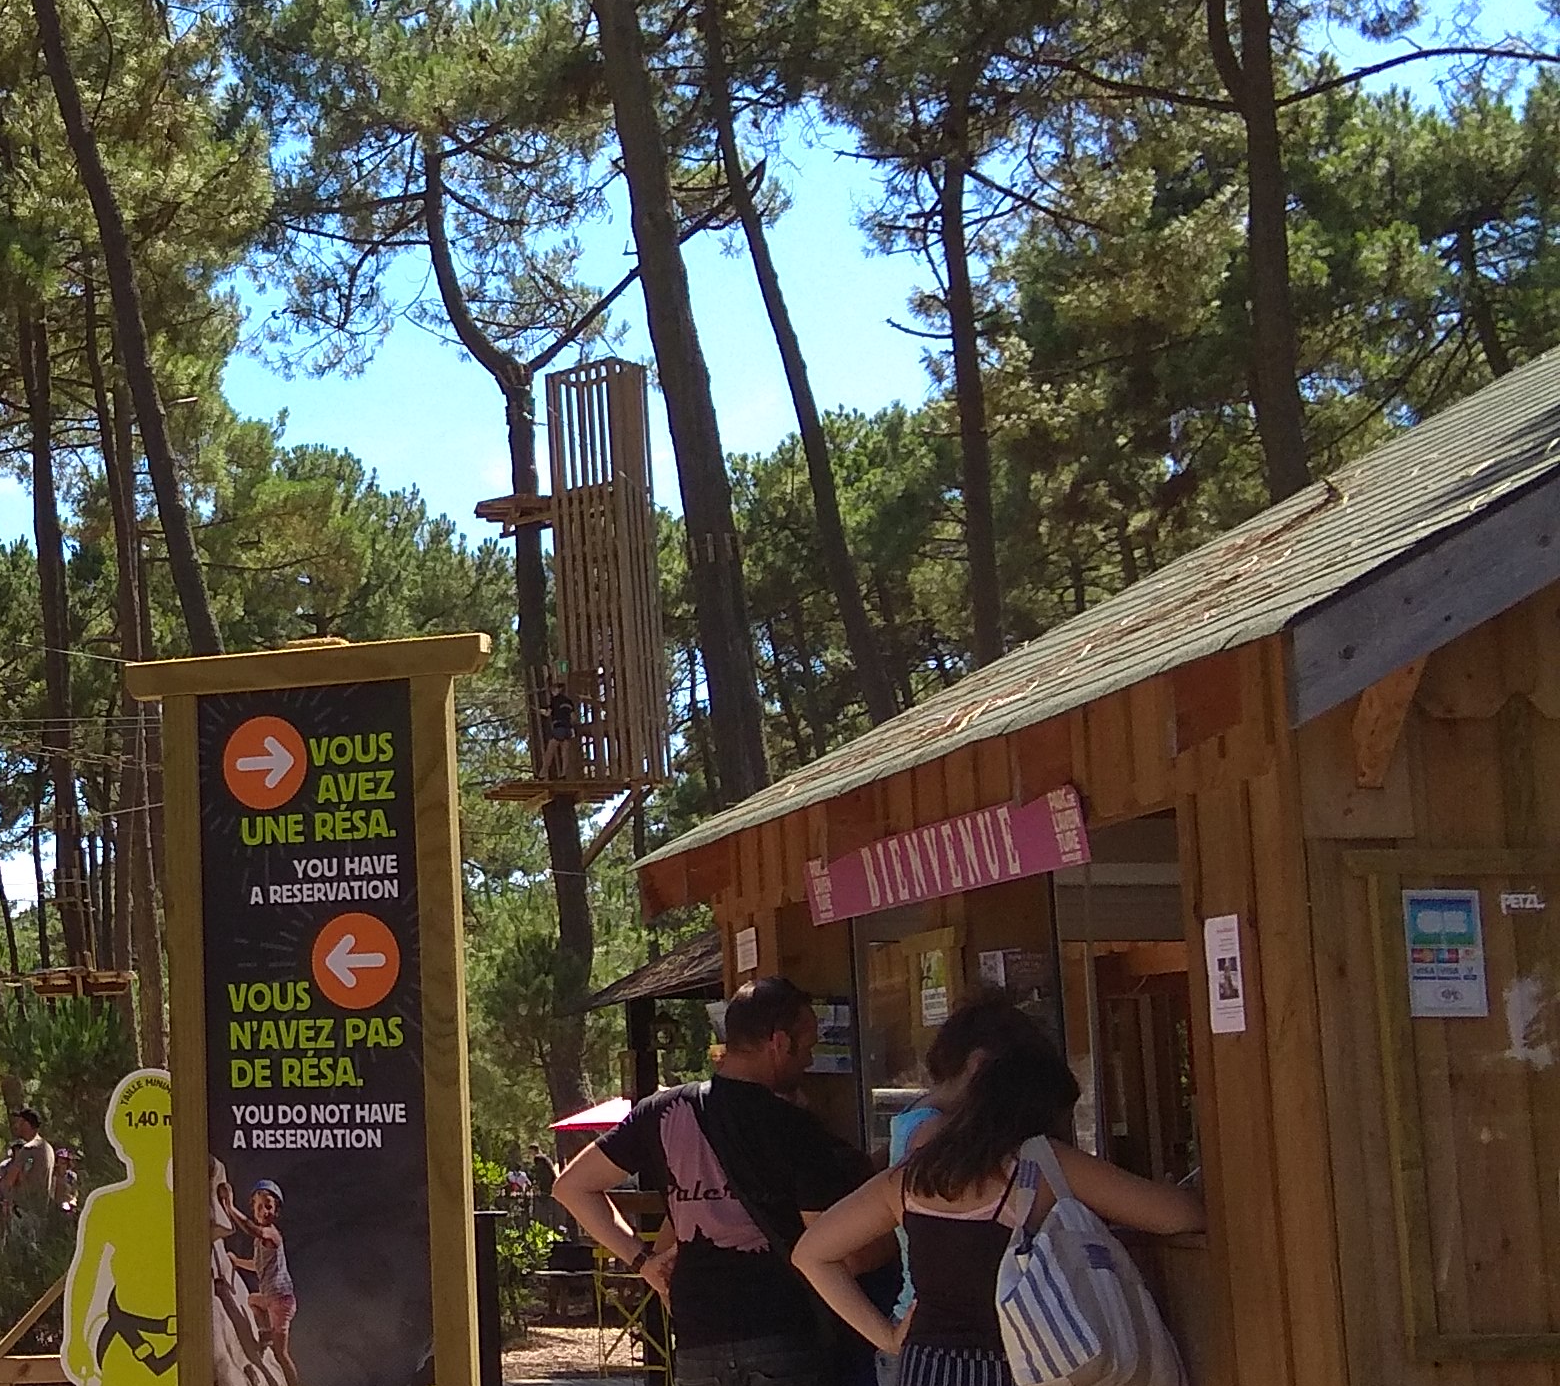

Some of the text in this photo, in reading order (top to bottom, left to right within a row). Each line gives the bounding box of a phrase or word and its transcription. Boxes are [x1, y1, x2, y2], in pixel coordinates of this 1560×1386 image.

[309, 732, 394, 766] VOUS
[317, 770, 396, 804] AVEZ
[241, 804, 397, 846] UNE RÉSA.
[293, 854, 399, 879] YOU HAVE
[861, 806, 1021, 907] BIENVENUE
[250, 879, 399, 905] A RESERVATION
[228, 981, 311, 1013] VOUS
[229, 1016, 404, 1050] N'AVEZ PAS
[231, 1050, 364, 1088] DE RÉSA.
[120, 1080, 144, 1105] TAILLE
[125, 1110, 159, 1129] 1,40
[231, 1103, 407, 1125] YOU DO NOT HAVE
[233, 1128, 382, 1149] A RESERVATION
